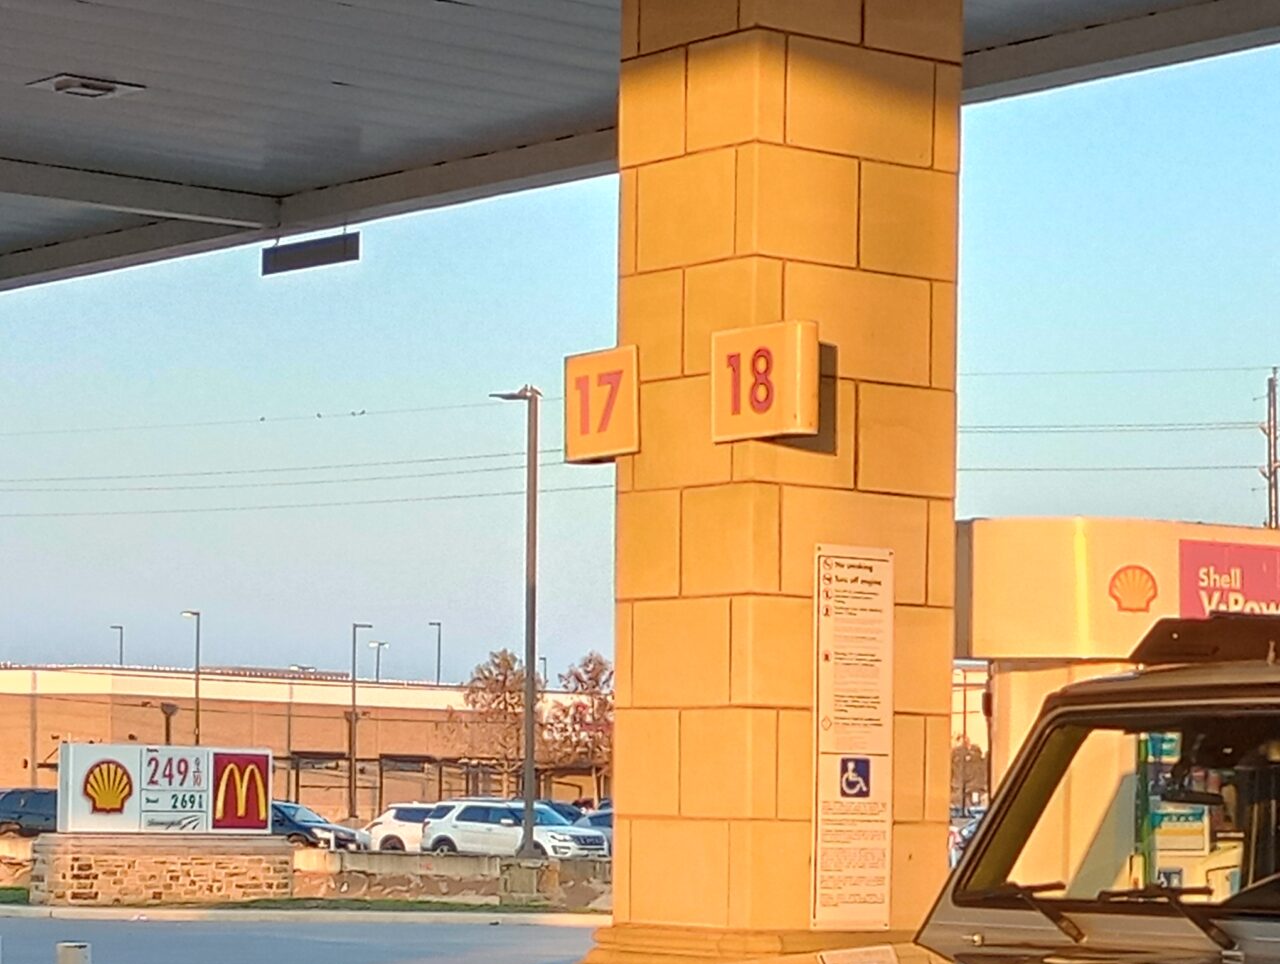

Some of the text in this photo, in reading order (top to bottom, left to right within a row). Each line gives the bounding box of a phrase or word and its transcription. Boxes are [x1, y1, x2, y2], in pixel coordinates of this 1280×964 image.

[727, 347, 775, 414] 18
[575, 370, 623, 435] 17
[1199, 566, 1242, 589] Shell
[147, 757, 189, 786] 249
[171, 793, 196, 810] 269
